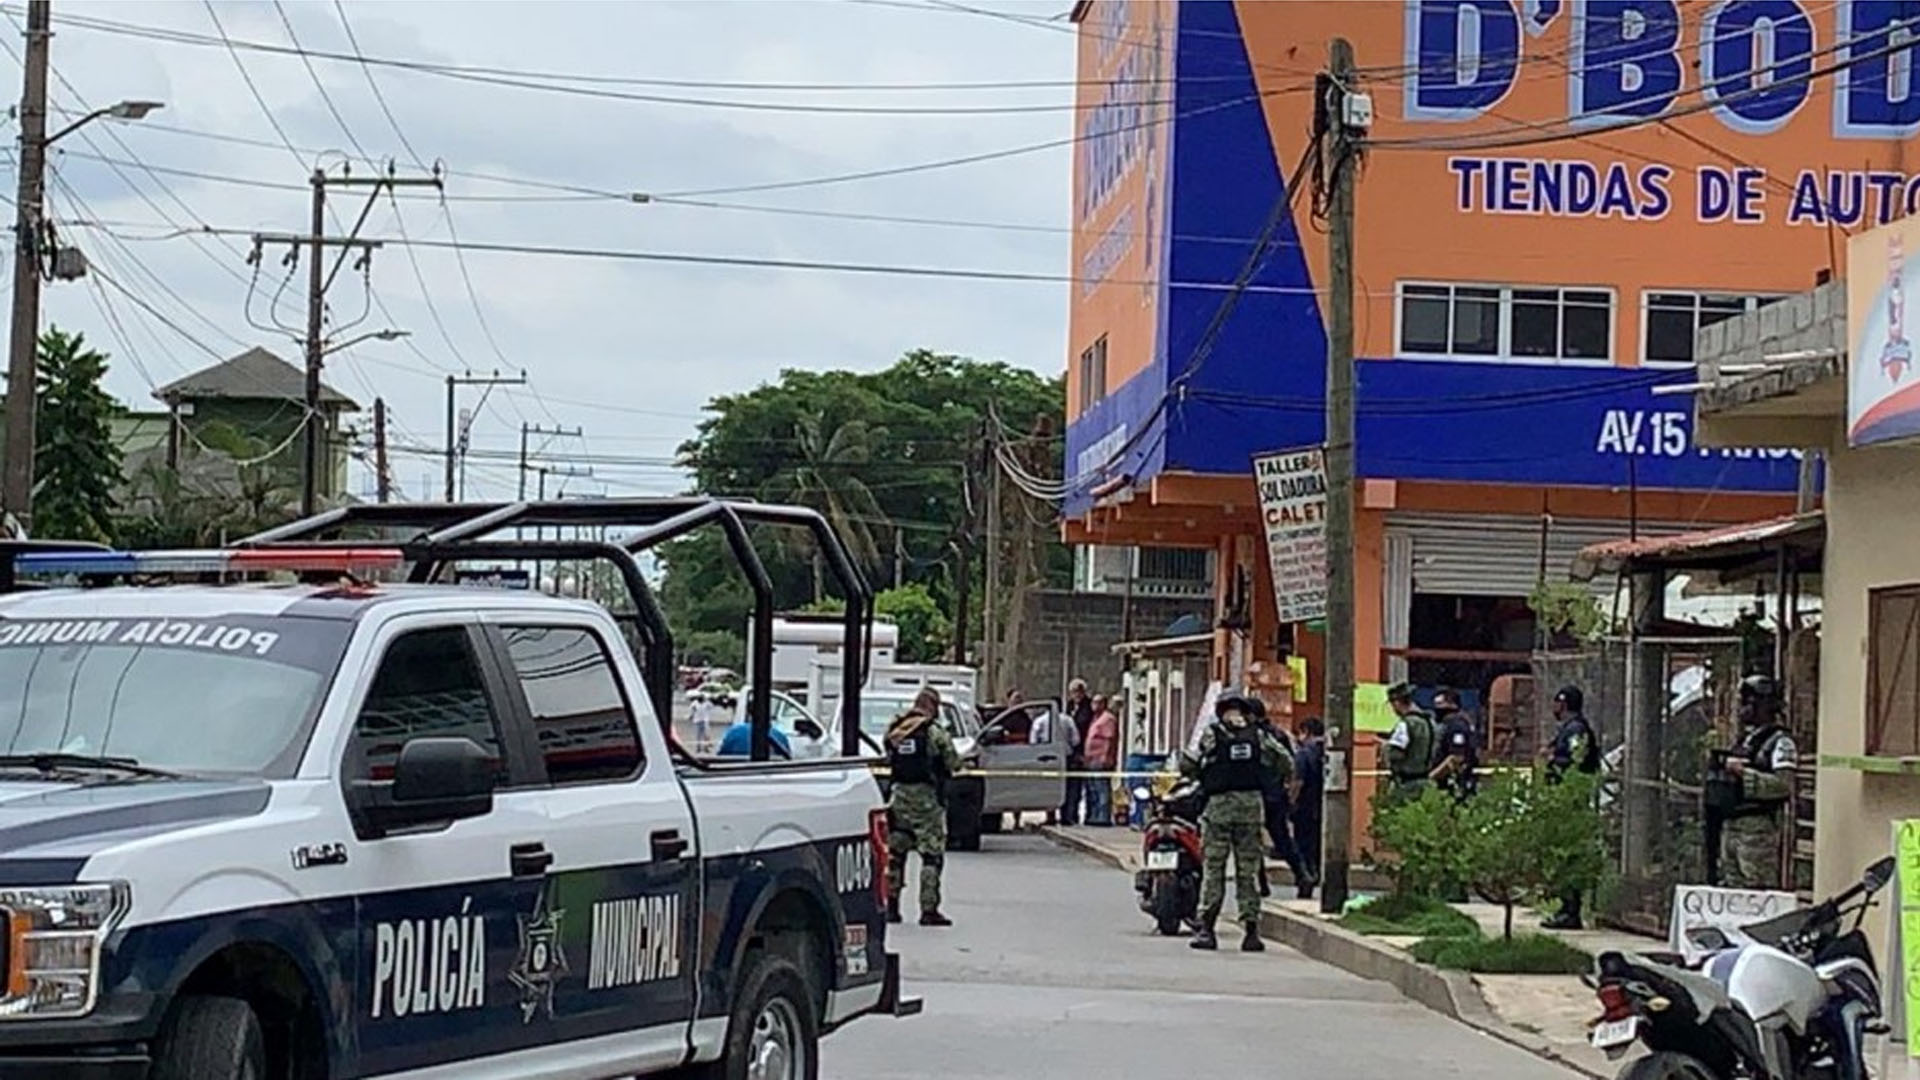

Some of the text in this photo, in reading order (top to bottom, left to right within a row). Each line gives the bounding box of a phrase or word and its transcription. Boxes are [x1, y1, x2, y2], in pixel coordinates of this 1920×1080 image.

[1449, 157, 1672, 219] TIENDAS
[1697, 167, 1766, 224] DE
[1258, 456, 1309, 477] TALLER
[1260, 473, 1327, 503] SOLDADURA
[1683, 890, 1778, 925] QUESO
[371, 894, 680, 1018] POLICÍA MUNICIPAL
